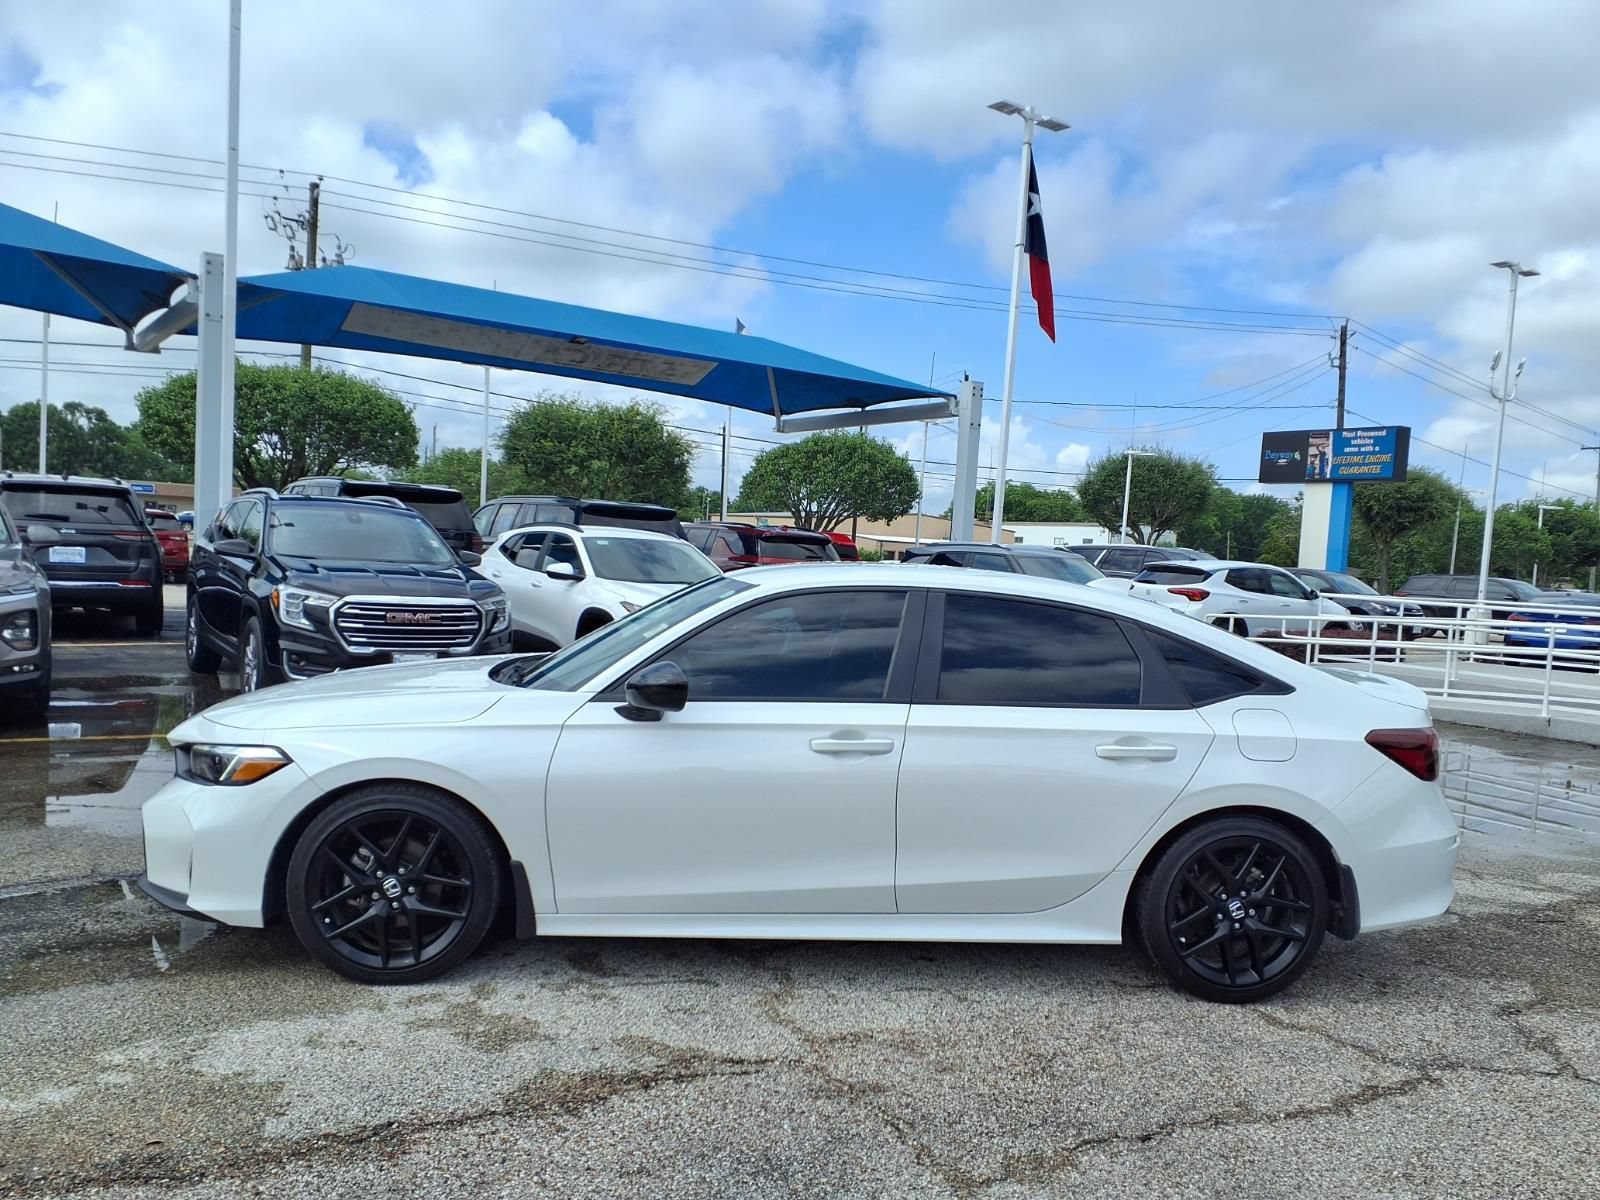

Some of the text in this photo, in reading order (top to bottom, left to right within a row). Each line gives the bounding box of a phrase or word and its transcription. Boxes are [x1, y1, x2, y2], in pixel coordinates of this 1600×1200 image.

[1360, 444, 1374, 452] with
[1265, 450, 1294, 462] Bayway
[1332, 453, 1393, 465] LIFETIME ENGINE
[1338, 464, 1383, 475] GUARANTEE
[386, 612, 441, 624] GMC
